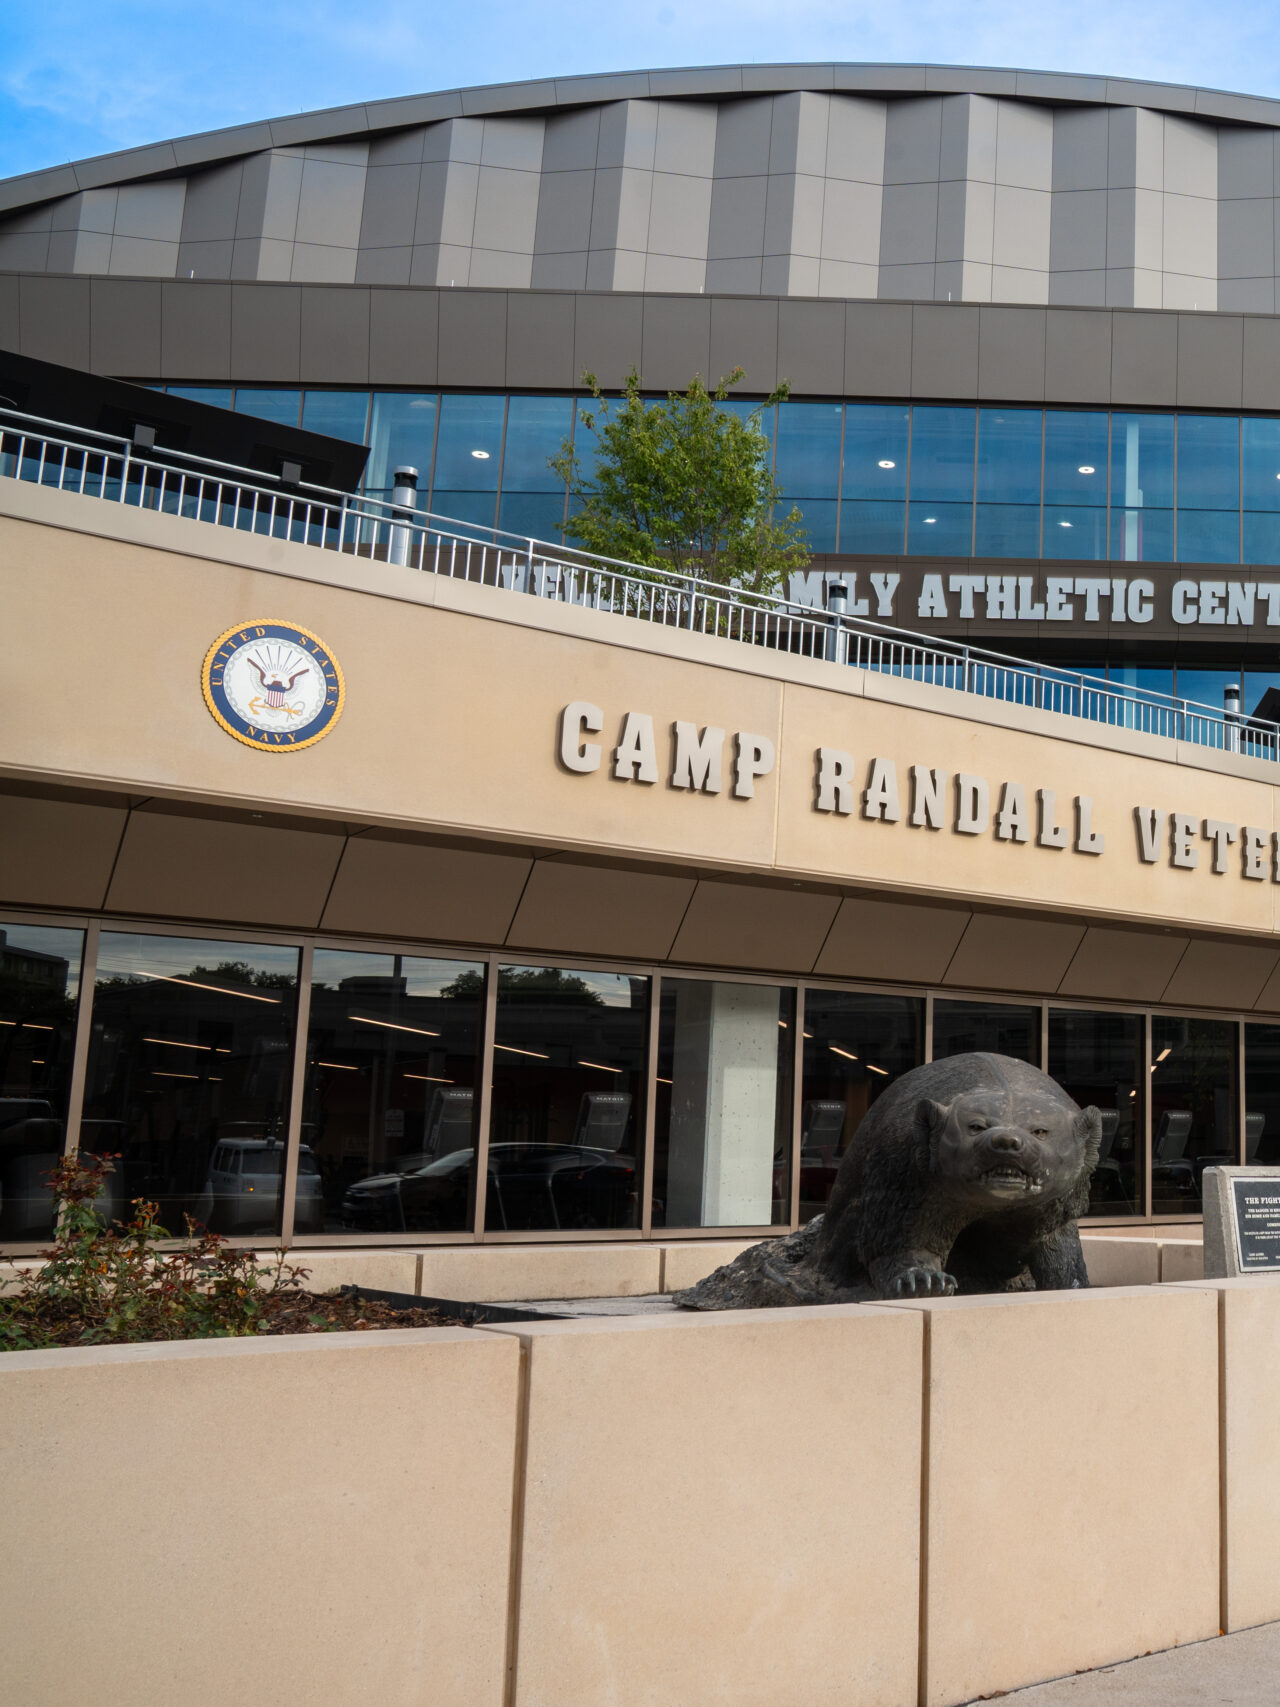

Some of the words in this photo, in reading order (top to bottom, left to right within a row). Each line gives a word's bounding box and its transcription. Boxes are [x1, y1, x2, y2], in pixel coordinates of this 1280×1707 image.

[918, 574, 1154, 623] ATHLETIC
[211, 627, 266, 686] UNITED
[298, 636, 338, 707] STATES
[245, 726, 297, 744] NAVY
[558, 700, 775, 799] CAMP
[814, 746, 1104, 855] RANDALL
